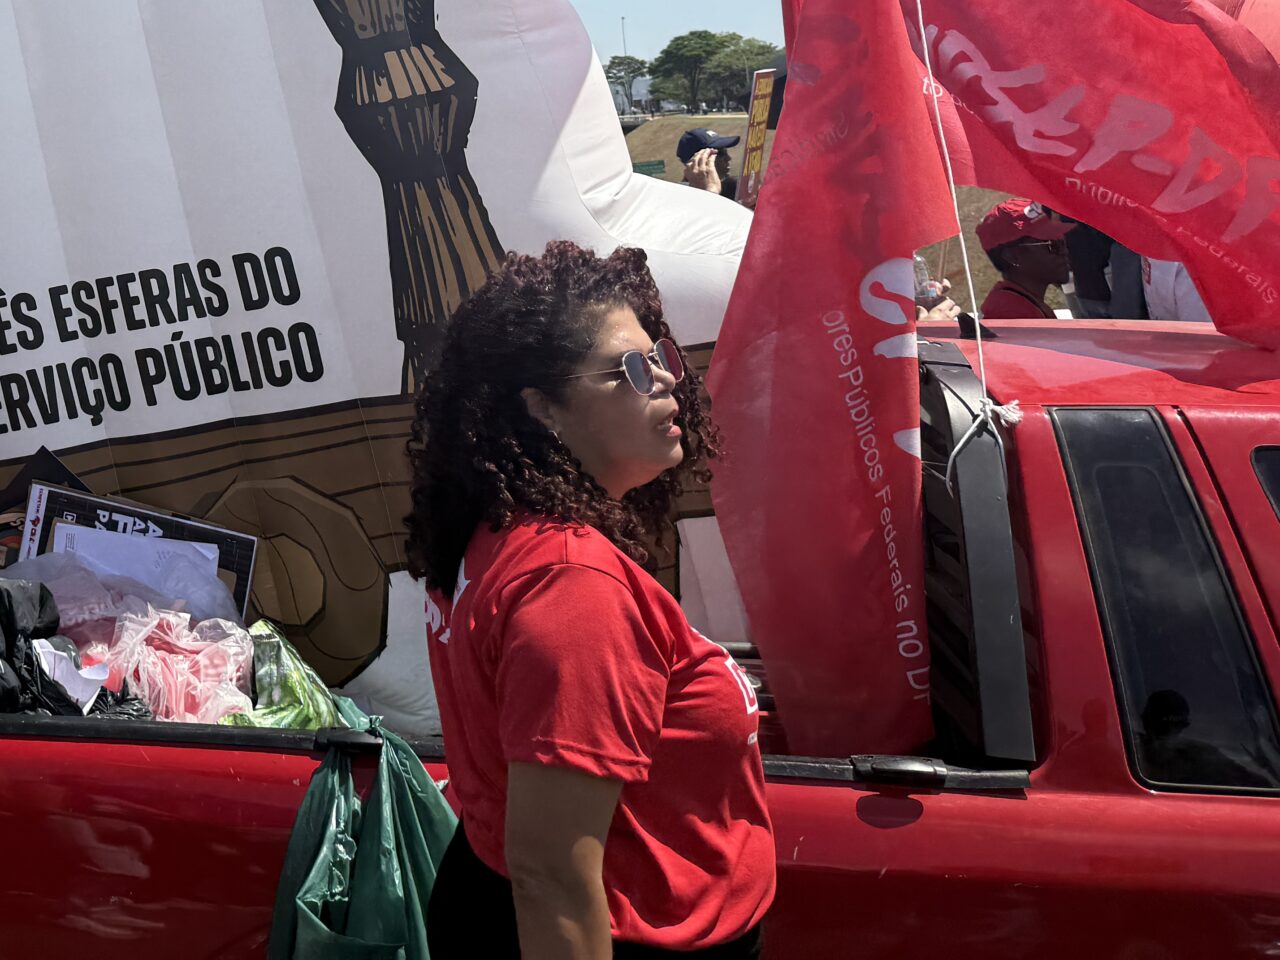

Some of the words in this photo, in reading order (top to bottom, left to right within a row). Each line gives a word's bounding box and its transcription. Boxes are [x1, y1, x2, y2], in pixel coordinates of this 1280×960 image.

[48, 258, 229, 343] ESFERAS
[231, 246, 302, 312] DO
[134, 322, 324, 407] PÚBLICO
[838, 366, 884, 482] Públicos
[874, 485, 911, 613] Federais
[895, 619, 924, 658] no
